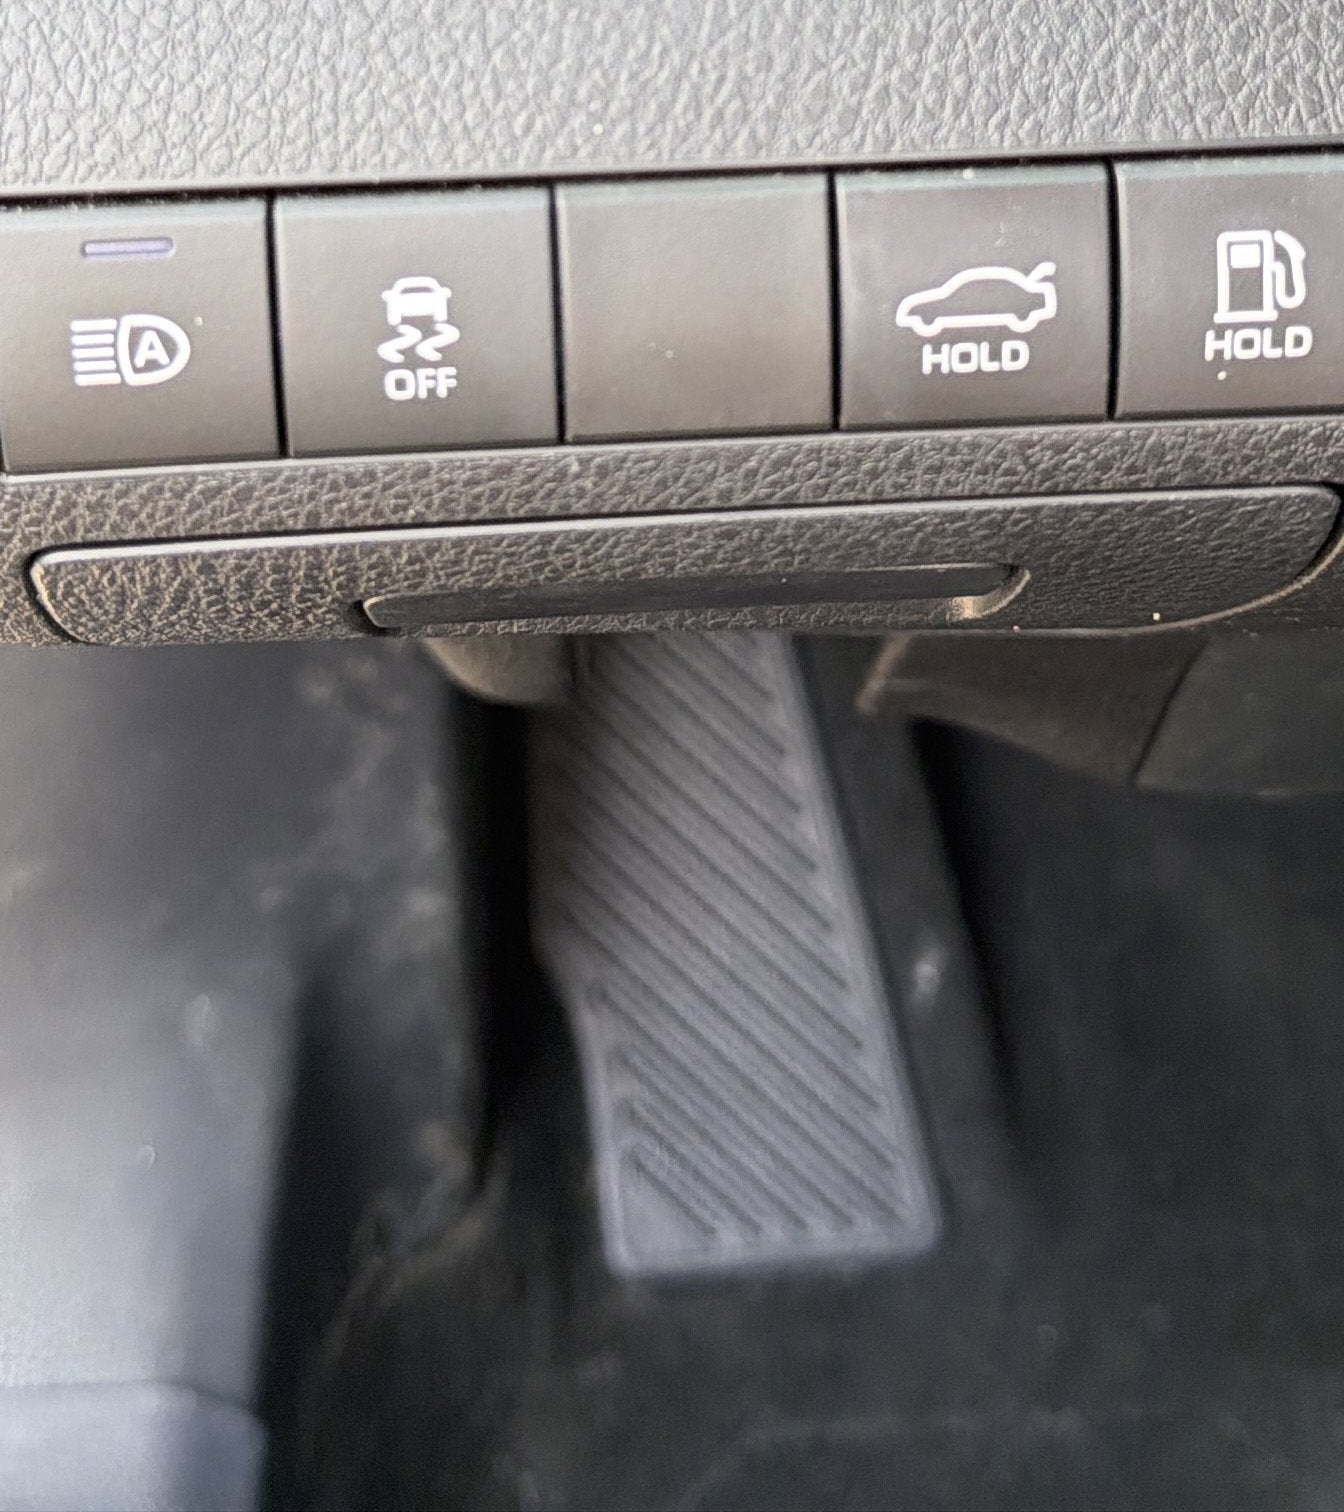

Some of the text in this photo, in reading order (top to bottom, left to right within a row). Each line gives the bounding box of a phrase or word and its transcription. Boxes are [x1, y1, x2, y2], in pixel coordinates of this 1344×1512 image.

[922, 340, 1030, 375] HOLD
[1204, 325, 1313, 362] HOLD
[383, 366, 458, 401] OFF
